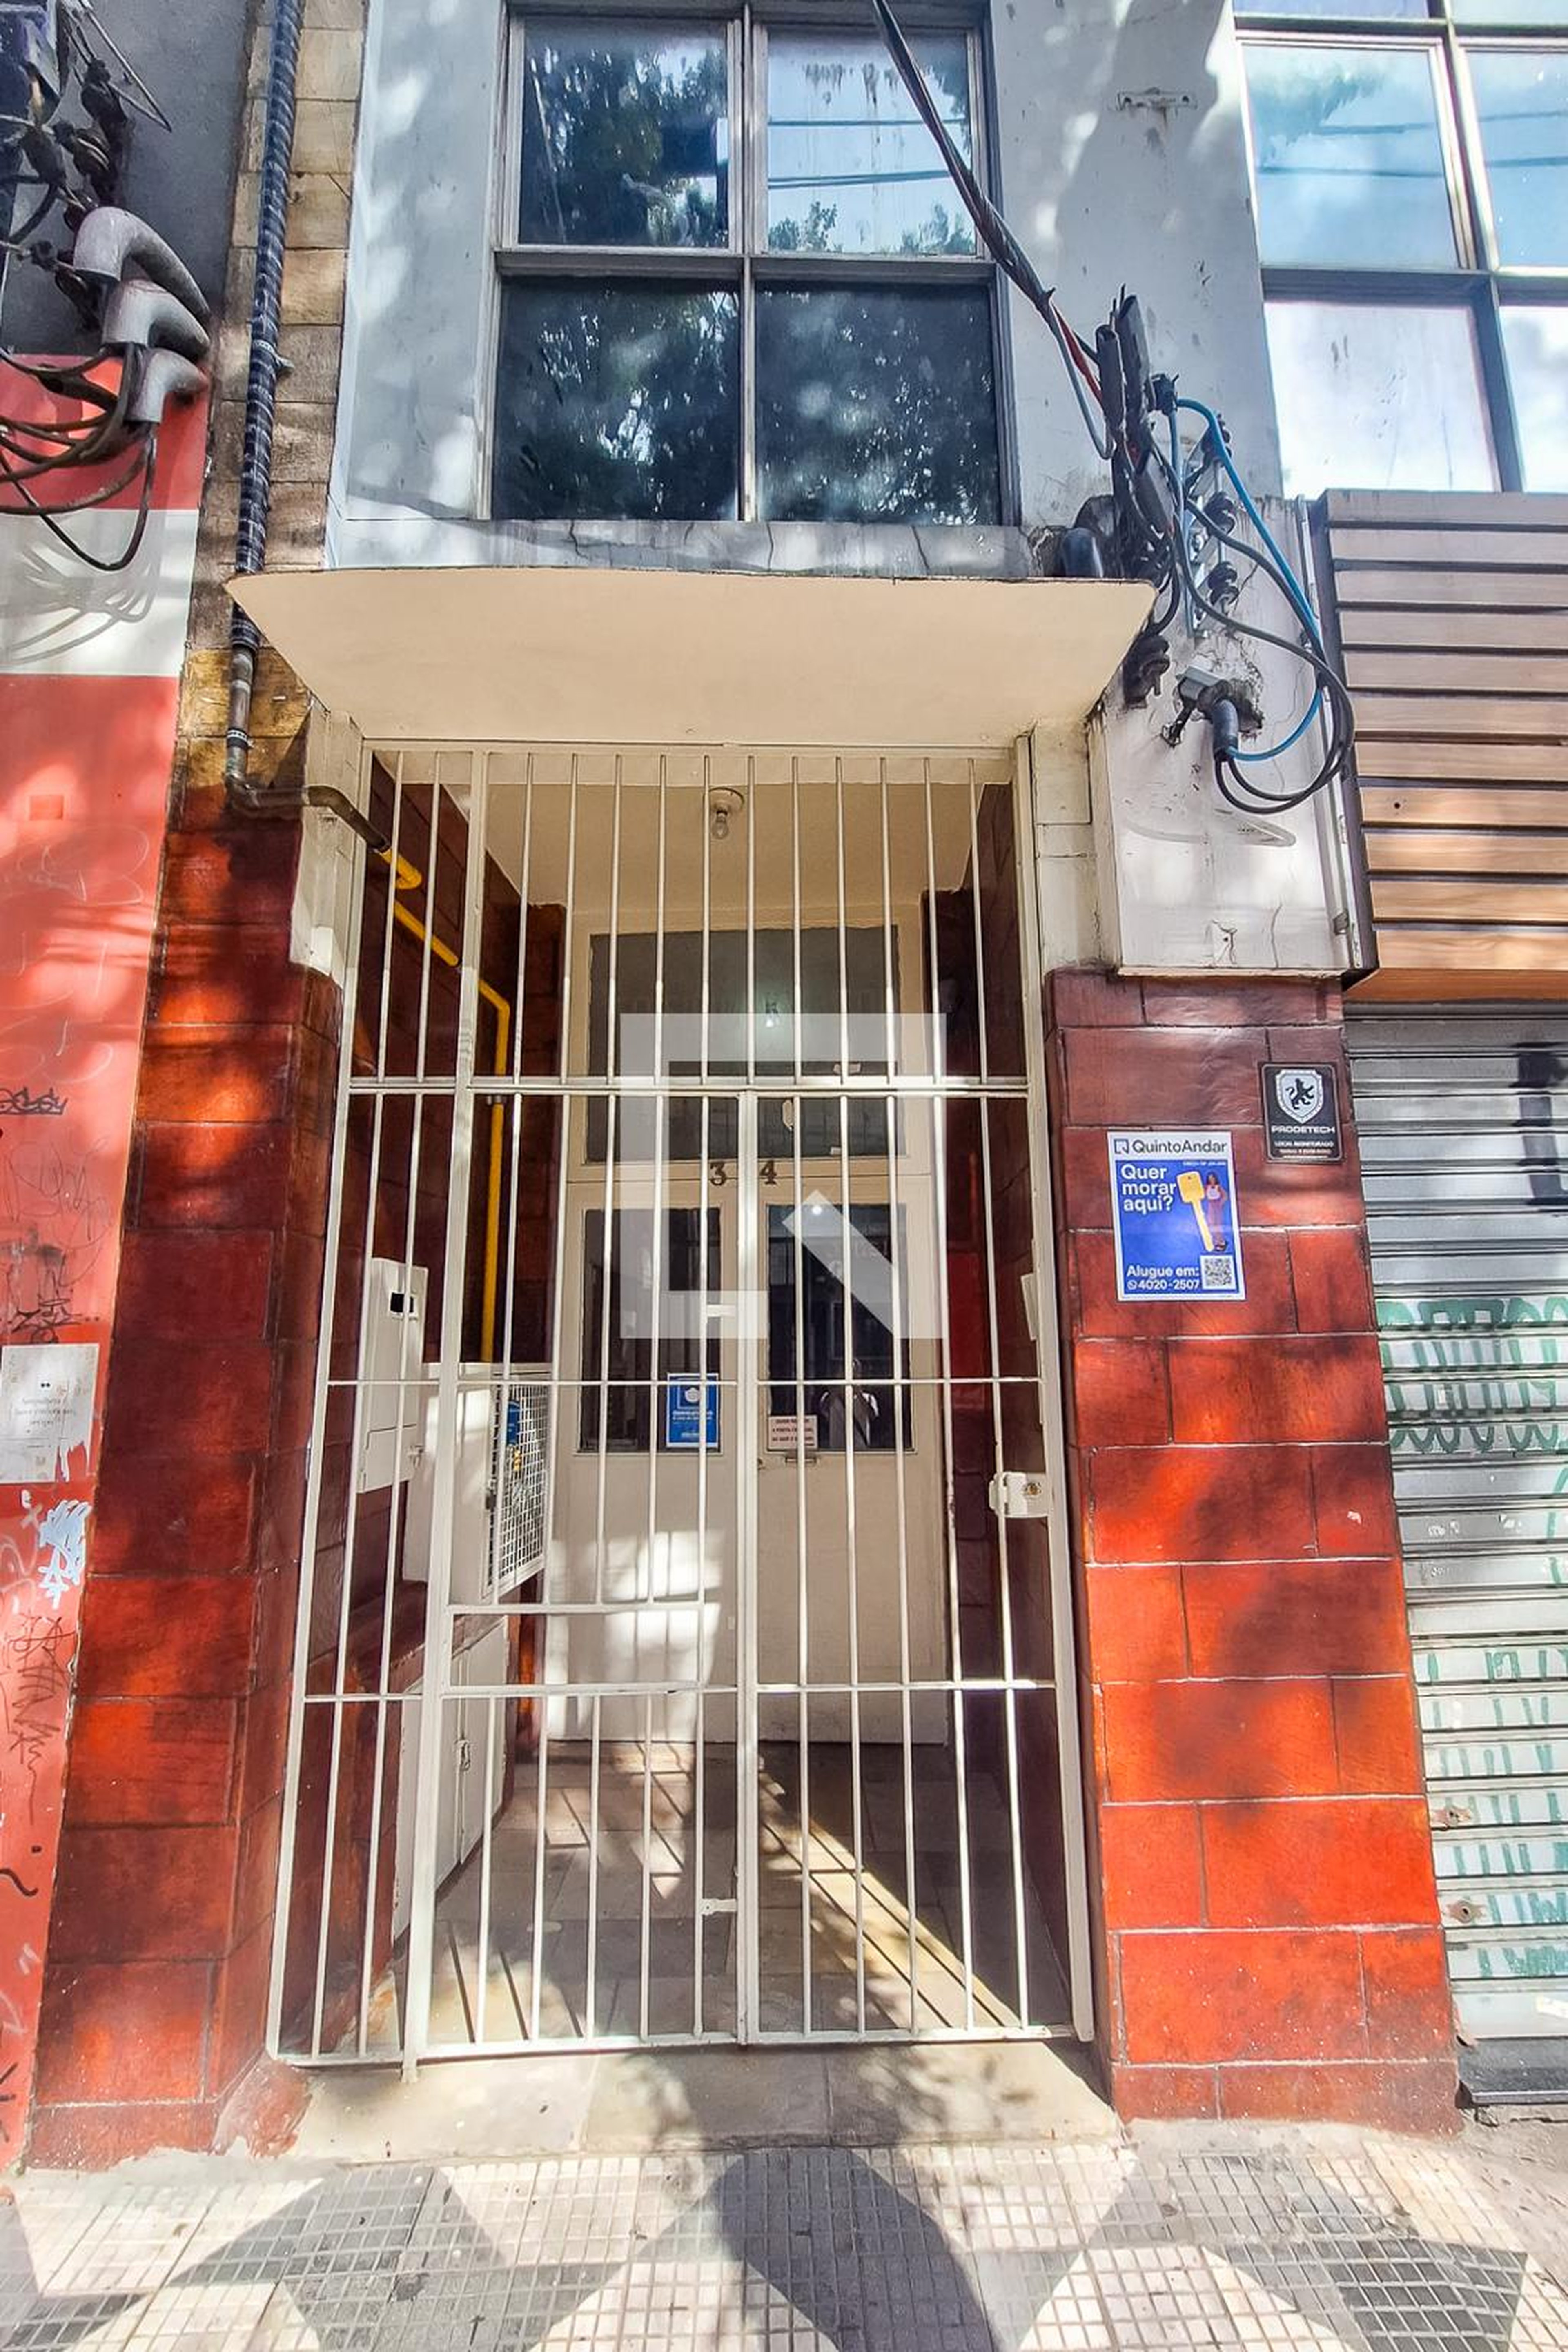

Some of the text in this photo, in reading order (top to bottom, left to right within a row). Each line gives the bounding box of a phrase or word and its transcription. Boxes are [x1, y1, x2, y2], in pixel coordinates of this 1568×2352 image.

[1271, 1125, 1335, 1134] PRODETECH
[1132, 1139, 1227, 1154] QuintoAndar
[1121, 1164, 1167, 1179] Quer
[1123, 1183, 1176, 1195] morar
[1124, 1195, 1173, 1215] aqui?
[1127, 1265, 1200, 1278] Alugue em:
[1138, 1278, 1200, 1290] 4020-2507
